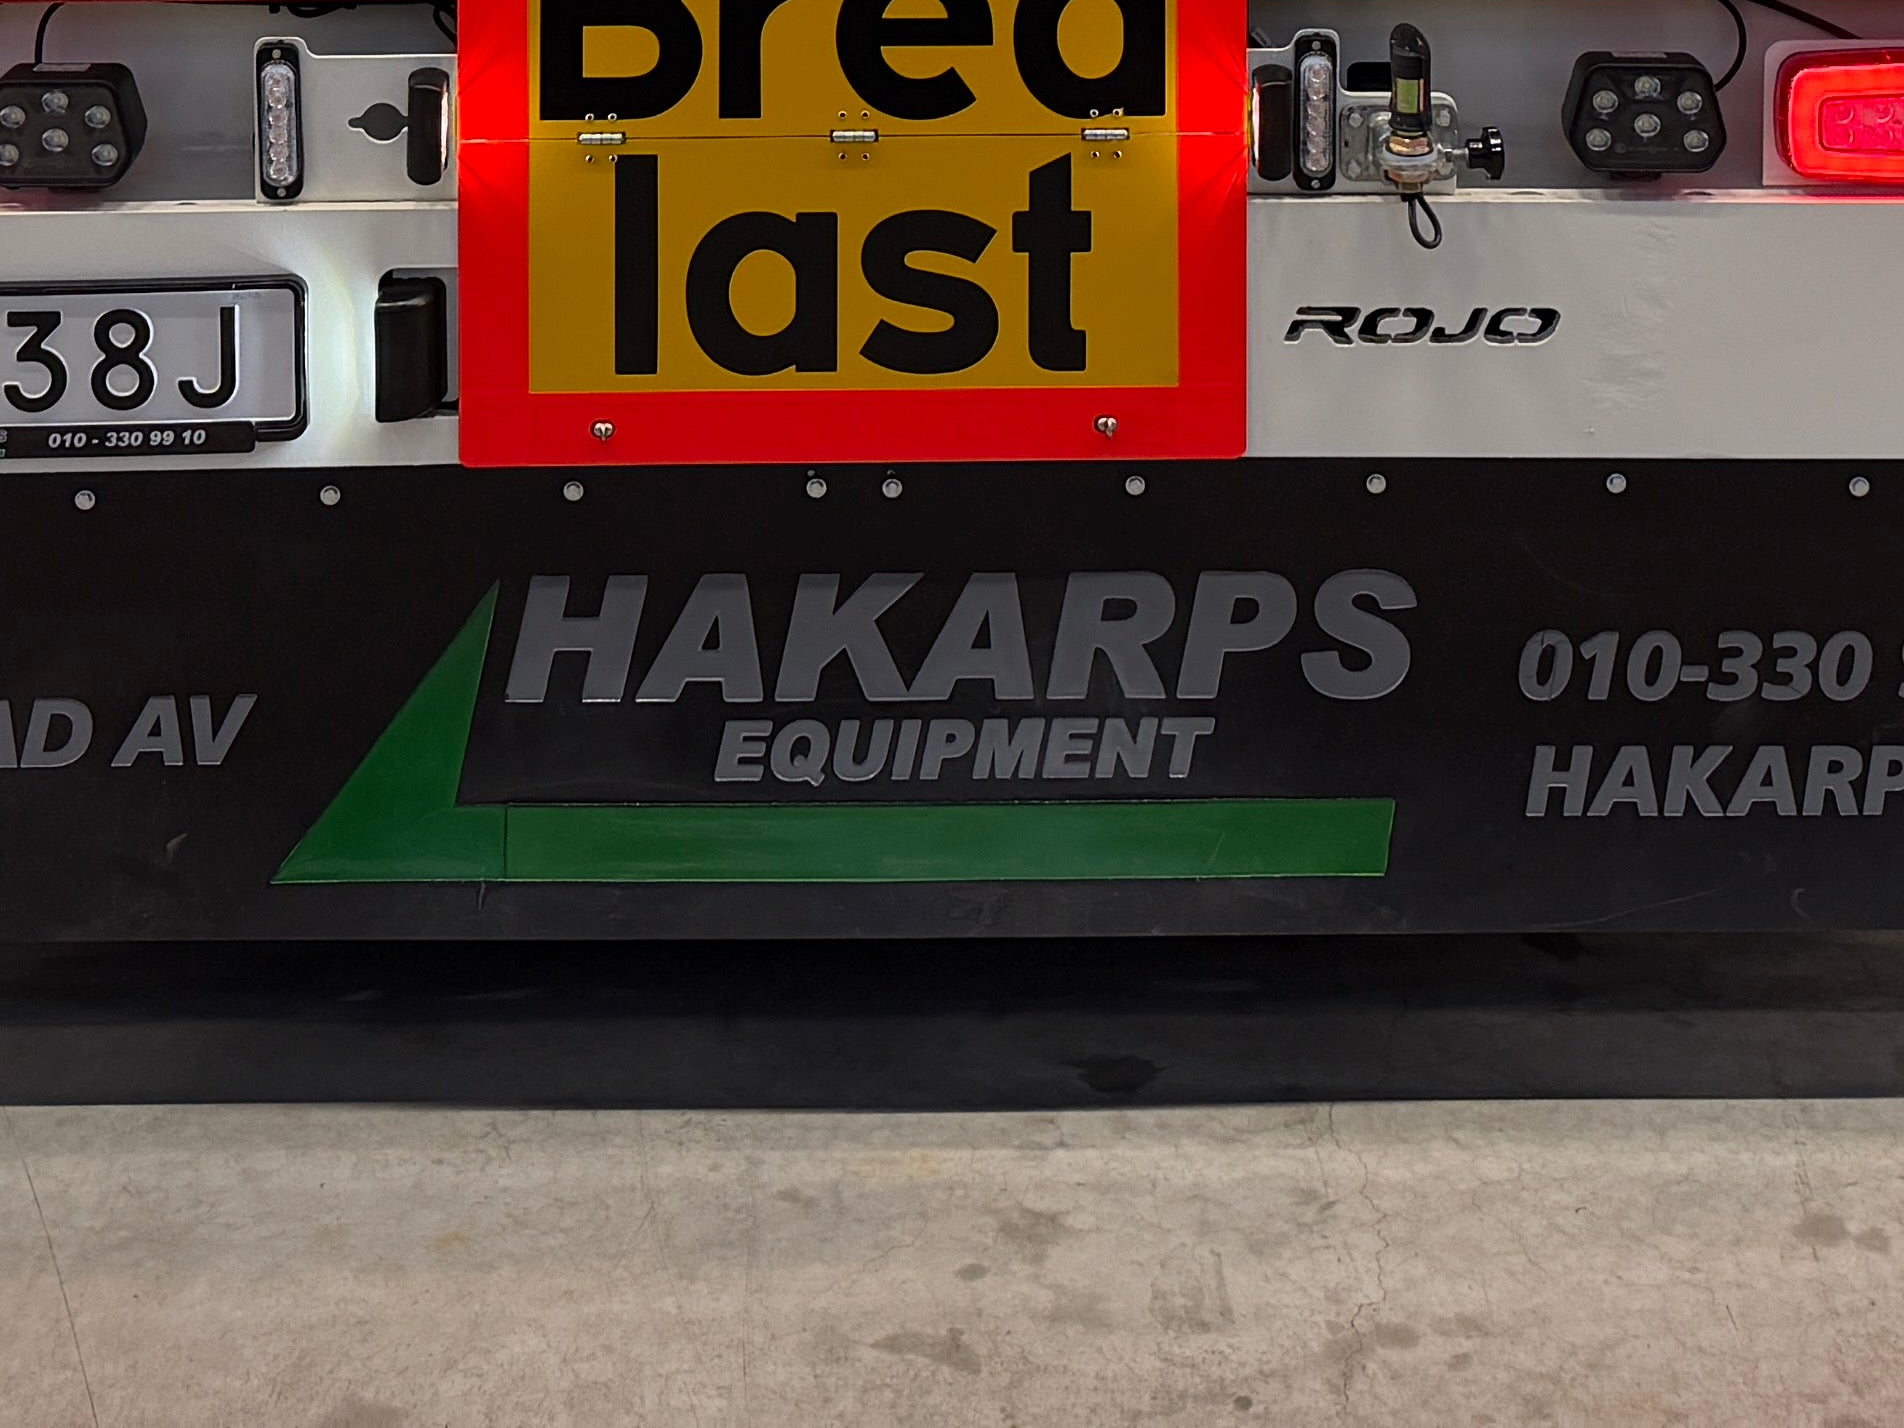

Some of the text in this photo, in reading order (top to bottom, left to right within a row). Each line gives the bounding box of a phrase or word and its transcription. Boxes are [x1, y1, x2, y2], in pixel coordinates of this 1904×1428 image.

[614, 152, 1092, 376] last
[3, 303, 241, 414] 38J
[1284, 304, 1561, 347] ROJO
[47, 432, 88, 449] 010
[104, 430, 144, 447] 330
[149, 429, 177, 446] 99
[181, 428, 207, 445] 10
[504, 567, 1419, 704] HAKARPS
[1517, 628, 1873, 701] 010-330
[111, 693, 257, 768] AV
[713, 716, 1216, 786] EQUIPMENT
